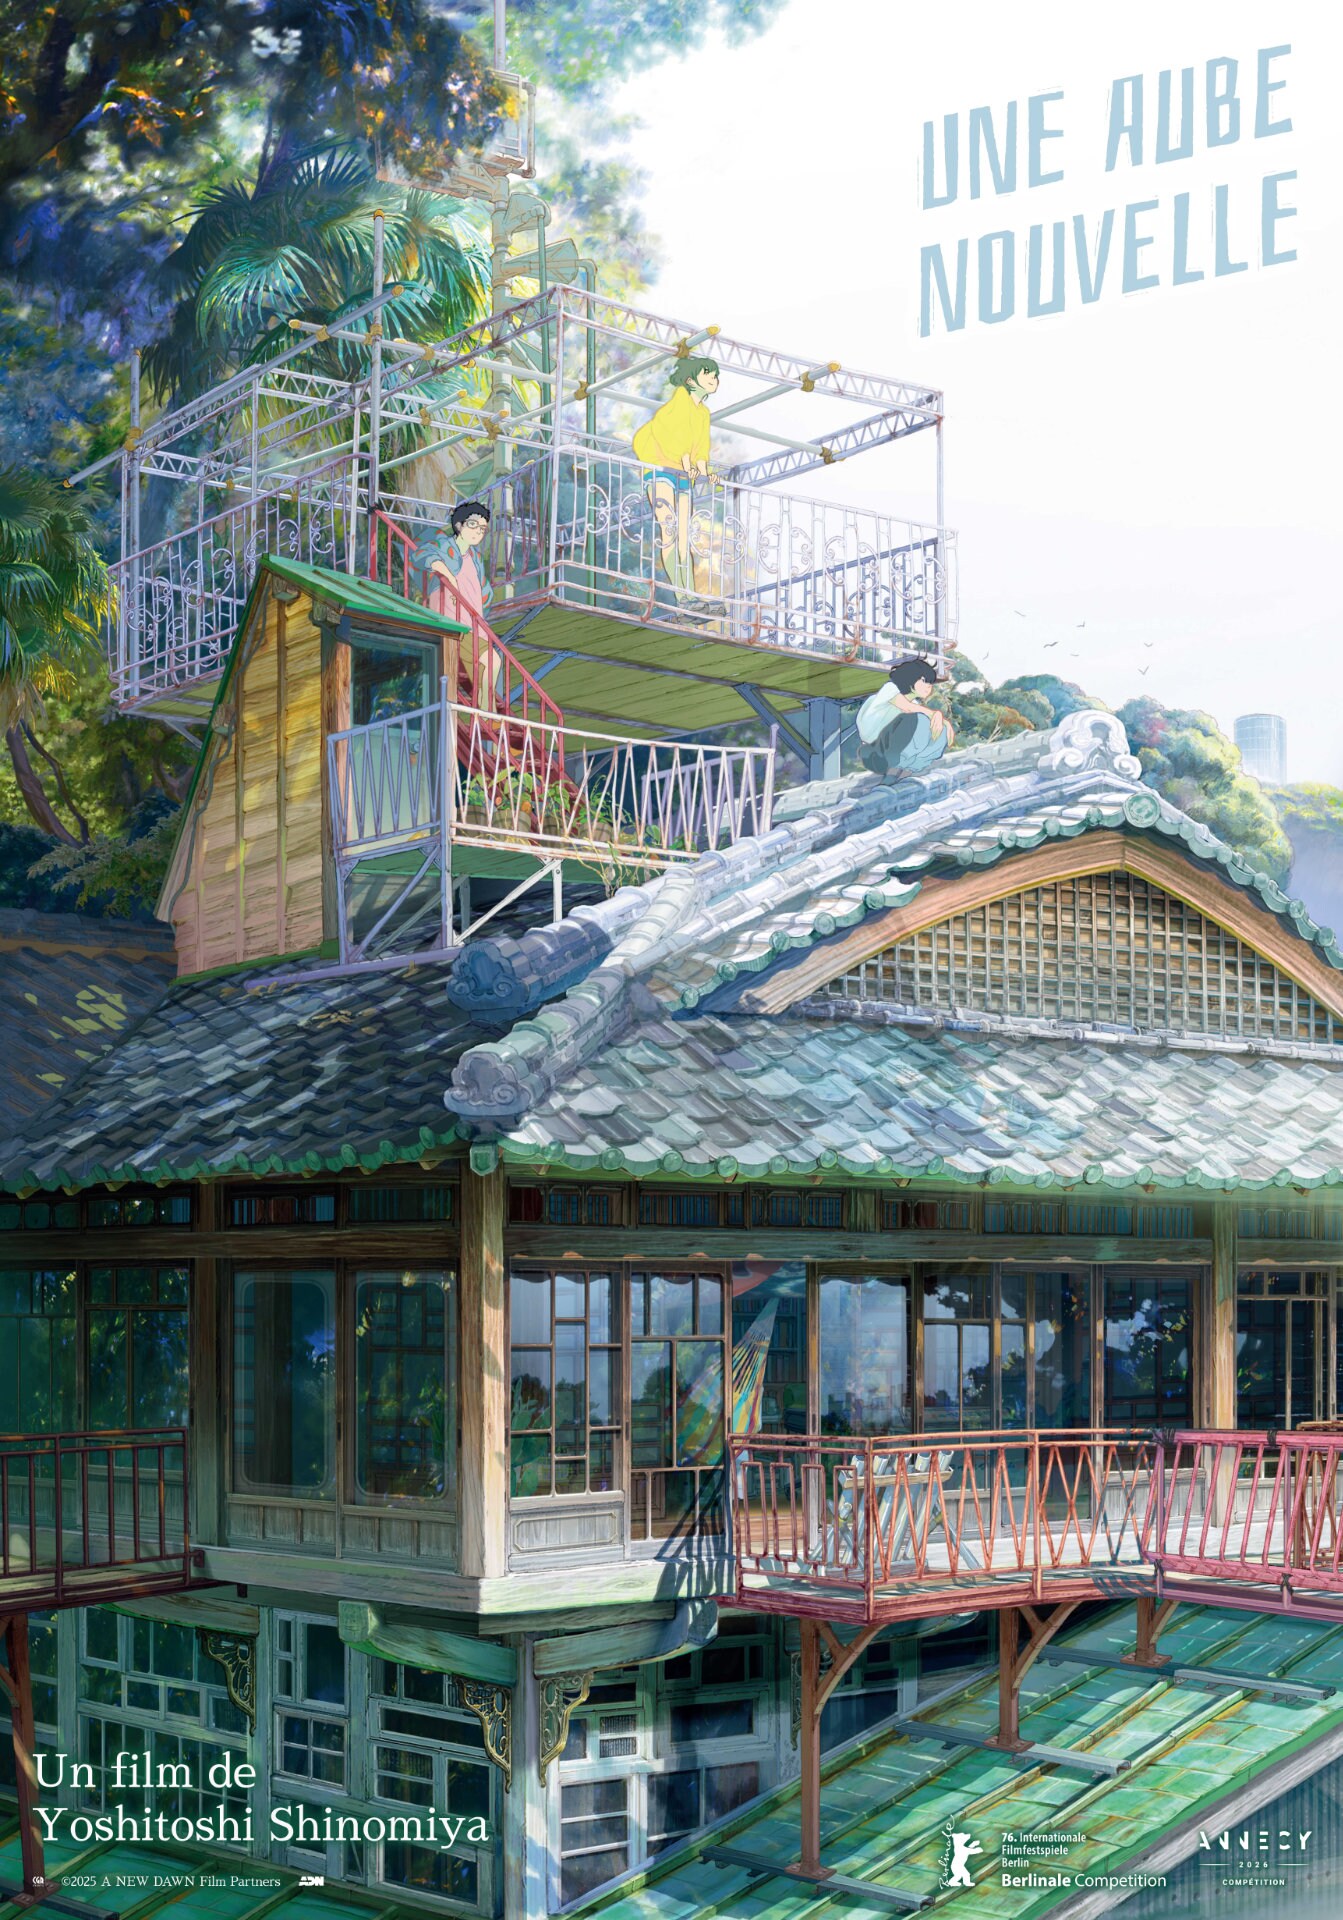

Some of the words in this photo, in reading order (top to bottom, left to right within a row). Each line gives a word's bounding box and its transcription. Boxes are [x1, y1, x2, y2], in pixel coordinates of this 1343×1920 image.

[922, 90, 1065, 211] UNE
[1104, 43, 1294, 173] AUBE
[920, 169, 1298, 338] NOUVELLE
[32, 1753, 96, 1788] Un
[111, 1751, 193, 1788] film
[208, 1751, 256, 1788] de
[32, 1804, 254, 1842] Yoshitoshi
[270, 1804, 489, 1849] Shinomiya
[1001, 1832, 1018, 1843] 76.
[1019, 1832, 1087, 1843] Internationale
[1199, 1831, 1313, 1850] ANNECY
[1001, 1844, 1069, 1857] Filmfestspiele
[1001, 1857, 1030, 1868] Berlin
[61, 1876, 97, 1887] ©2025
[101, 1876, 111, 1887] A
[116, 1876, 149, 1887] NEW
[153, 1876, 195, 1887] DAWN
[199, 1875, 226, 1887] Film
[230, 1876, 281, 1887] Partners
[1001, 1873, 1071, 1887] Berlinale
[1074, 1873, 1167, 1890] Competition
[1222, 1877, 1285, 1886] COMPÉTITION
